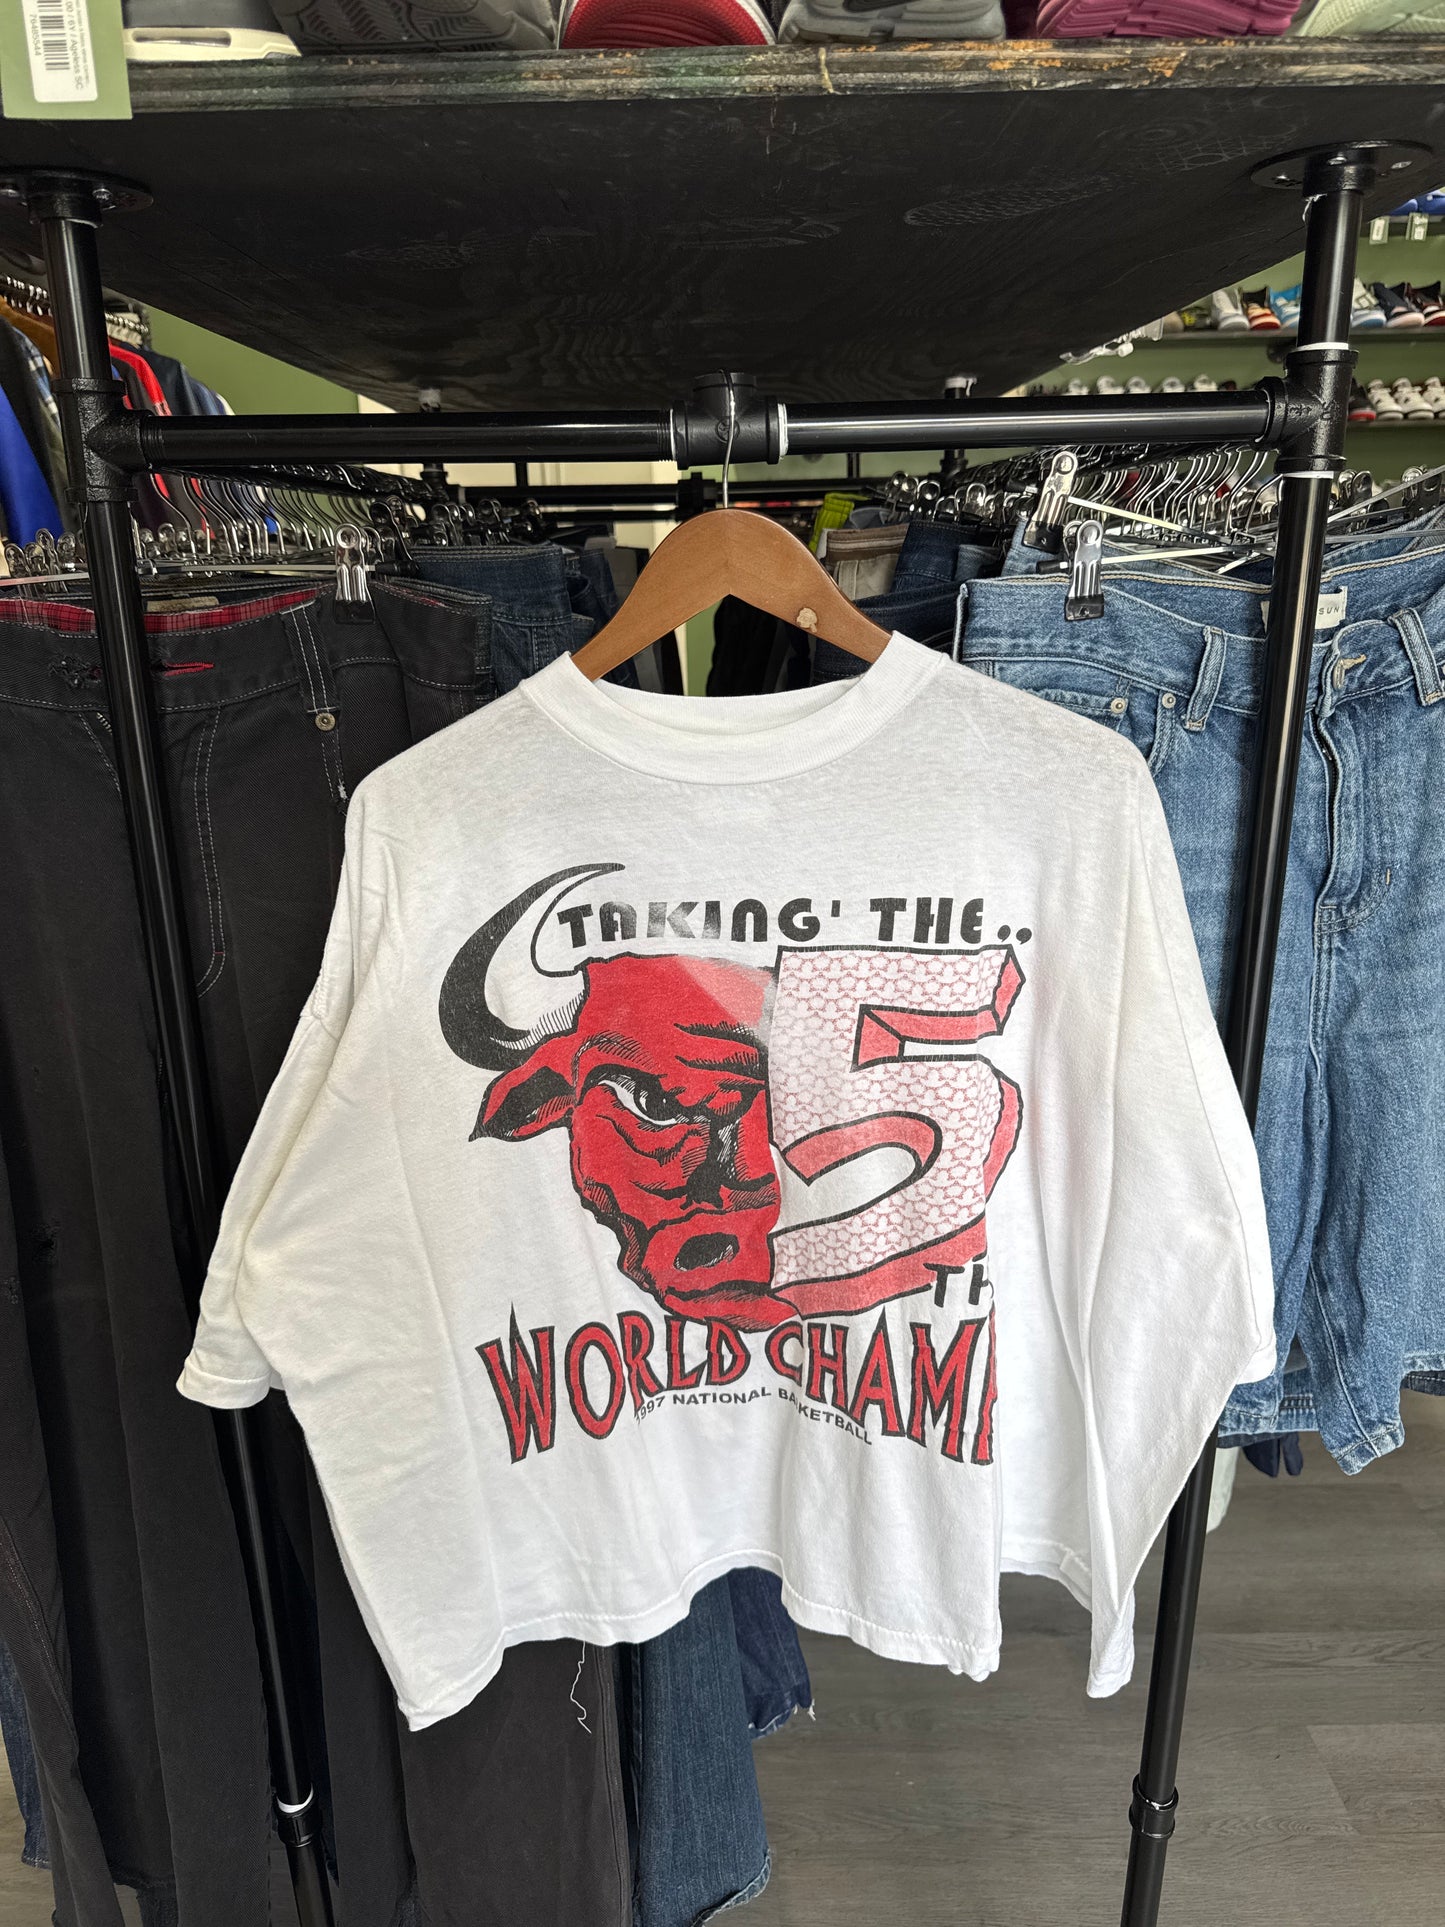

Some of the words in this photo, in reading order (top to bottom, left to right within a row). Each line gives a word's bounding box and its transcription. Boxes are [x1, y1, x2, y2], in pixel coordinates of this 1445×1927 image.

[69, 39, 81, 75] Ageless
[1318, 606, 1340, 615] SUN
[475, 1300, 751, 1464] WORLD
[672, 1386, 772, 1405] NATIONAL
[777, 1387, 873, 1446] BAKETBALL
